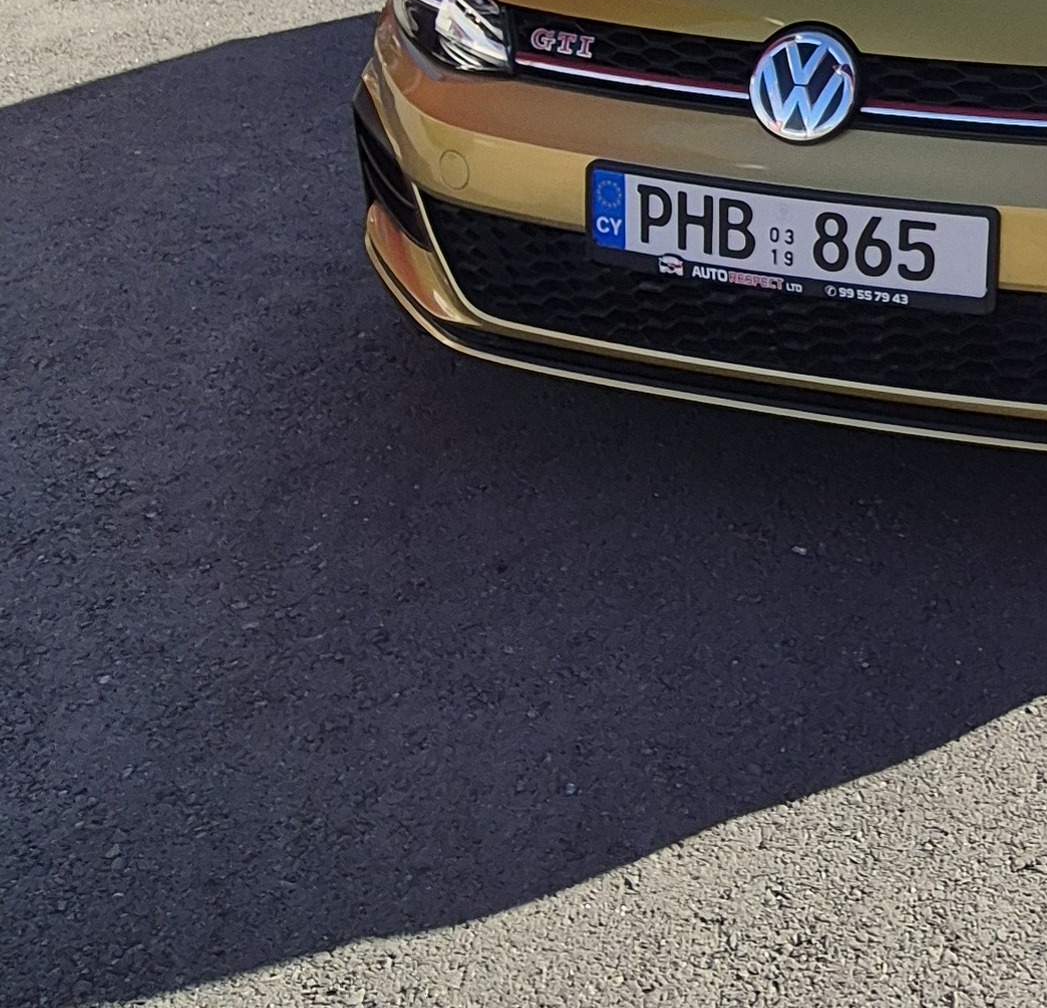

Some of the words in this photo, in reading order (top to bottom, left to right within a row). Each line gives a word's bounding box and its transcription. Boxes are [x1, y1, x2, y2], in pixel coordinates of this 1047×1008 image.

[530, 28, 595, 59] GTI
[596, 216, 623, 236] CY
[637, 183, 757, 260] PHB
[812, 211, 937, 282] 865
[769, 227, 795, 246] 03
[770, 249, 794, 267] 19
[786, 282, 803, 293] LTD
